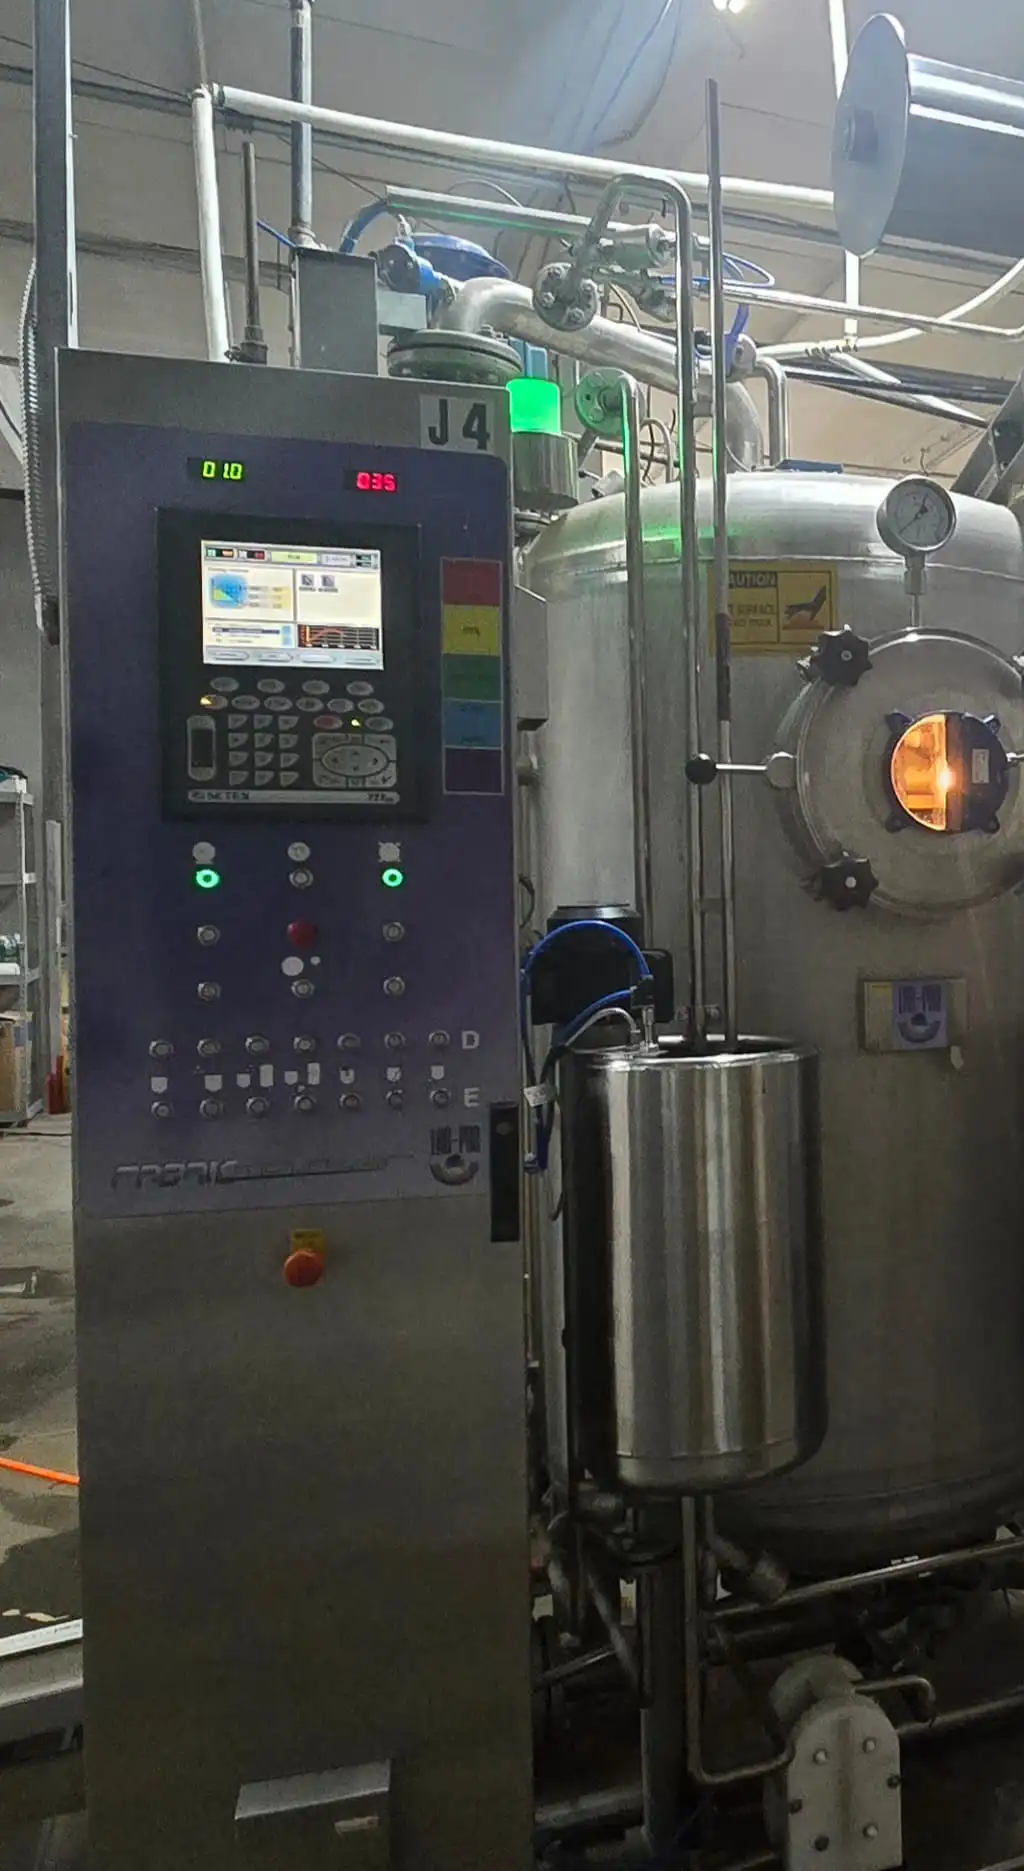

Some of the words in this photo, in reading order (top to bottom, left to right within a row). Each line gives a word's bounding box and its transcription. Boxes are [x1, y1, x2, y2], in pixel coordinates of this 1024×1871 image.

[729, 572, 775, 586] AUTION
[461, 1030, 480, 1050] D
[463, 1087, 480, 1107] E
